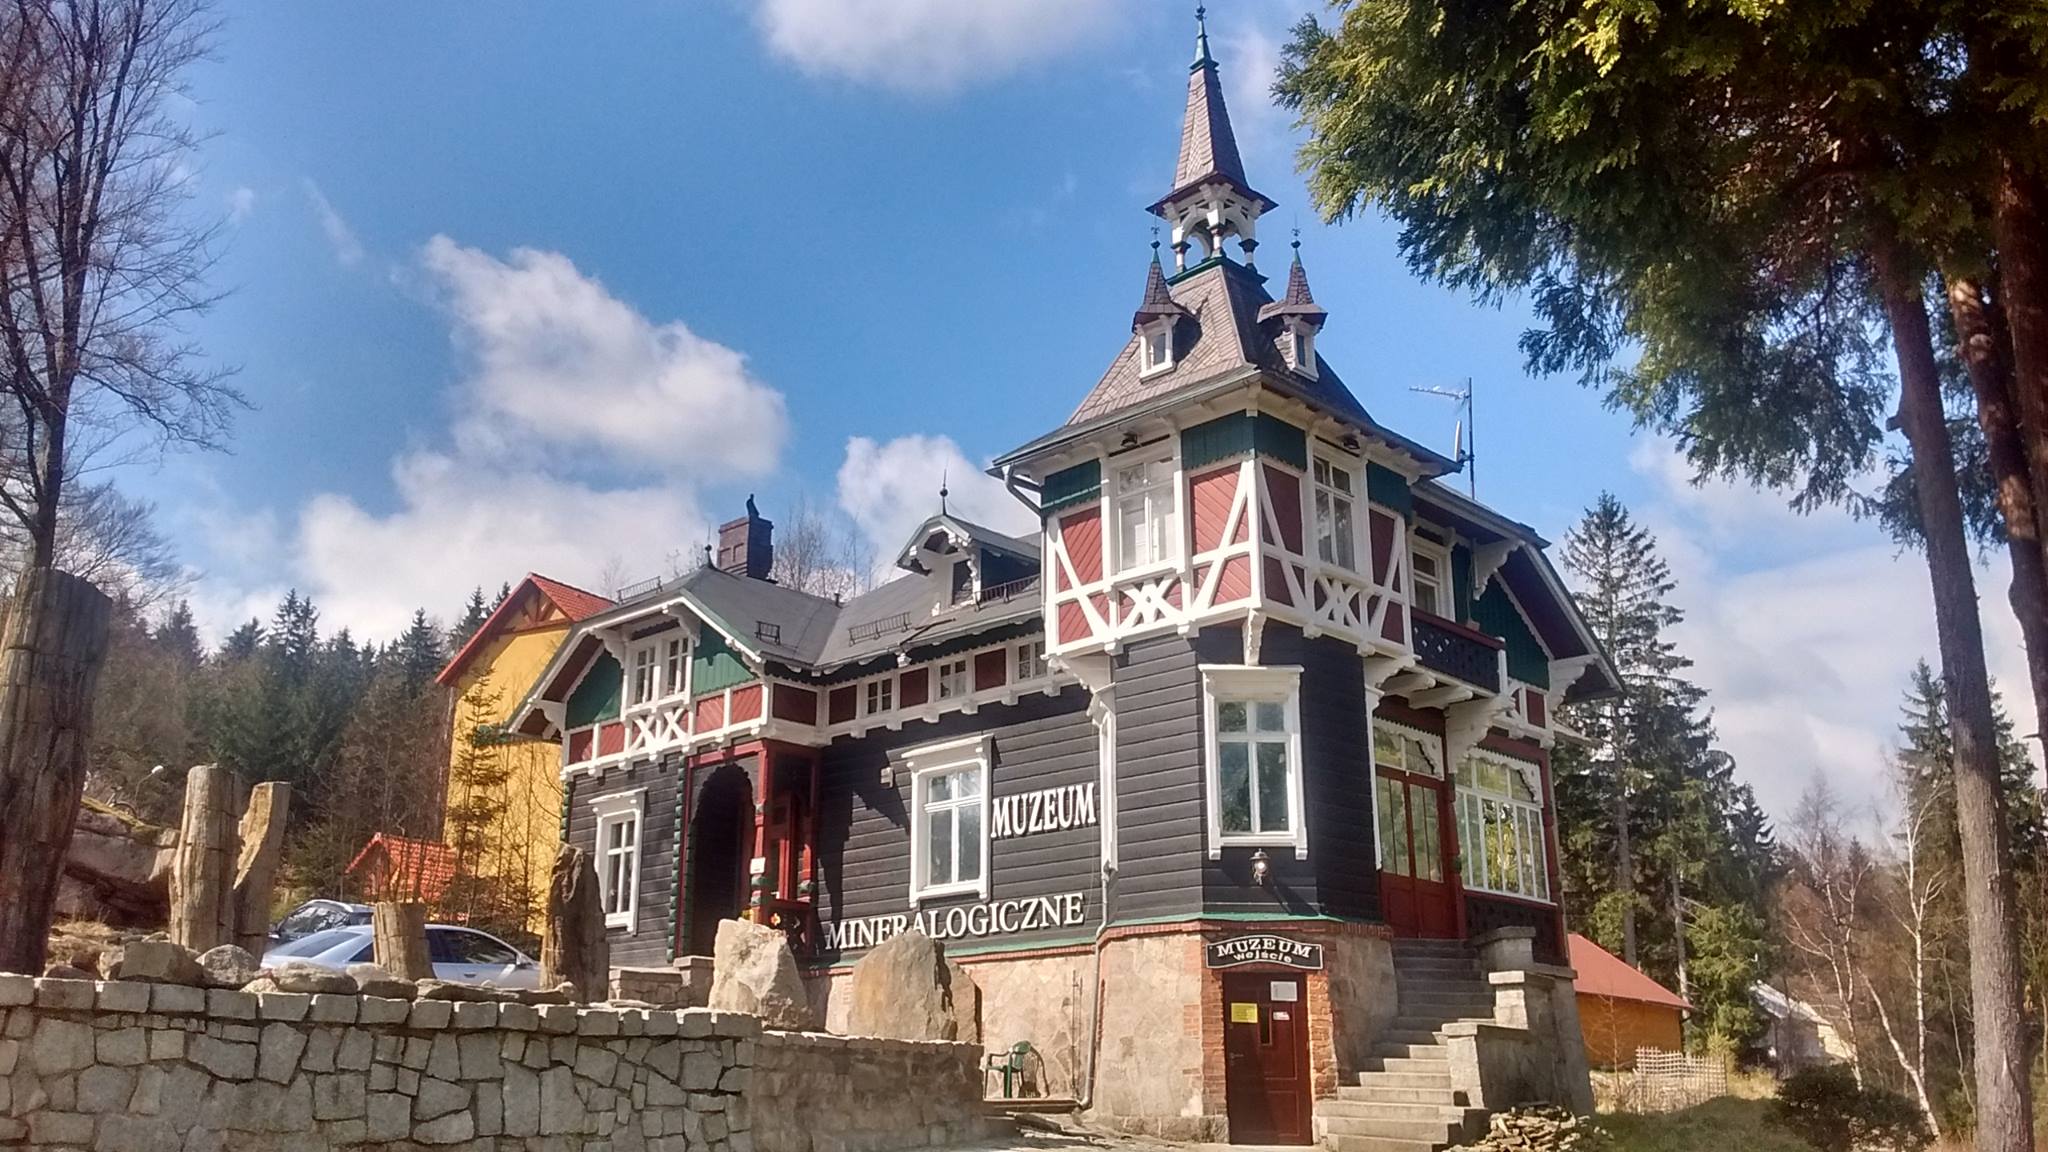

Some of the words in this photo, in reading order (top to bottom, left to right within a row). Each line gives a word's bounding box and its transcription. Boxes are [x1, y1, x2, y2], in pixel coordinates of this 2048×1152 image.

[990, 782, 1096, 838] MUZEUM
[825, 893, 1085, 949] MINERALOGICZNE
[1216, 938, 1312, 958] MUZEUM
